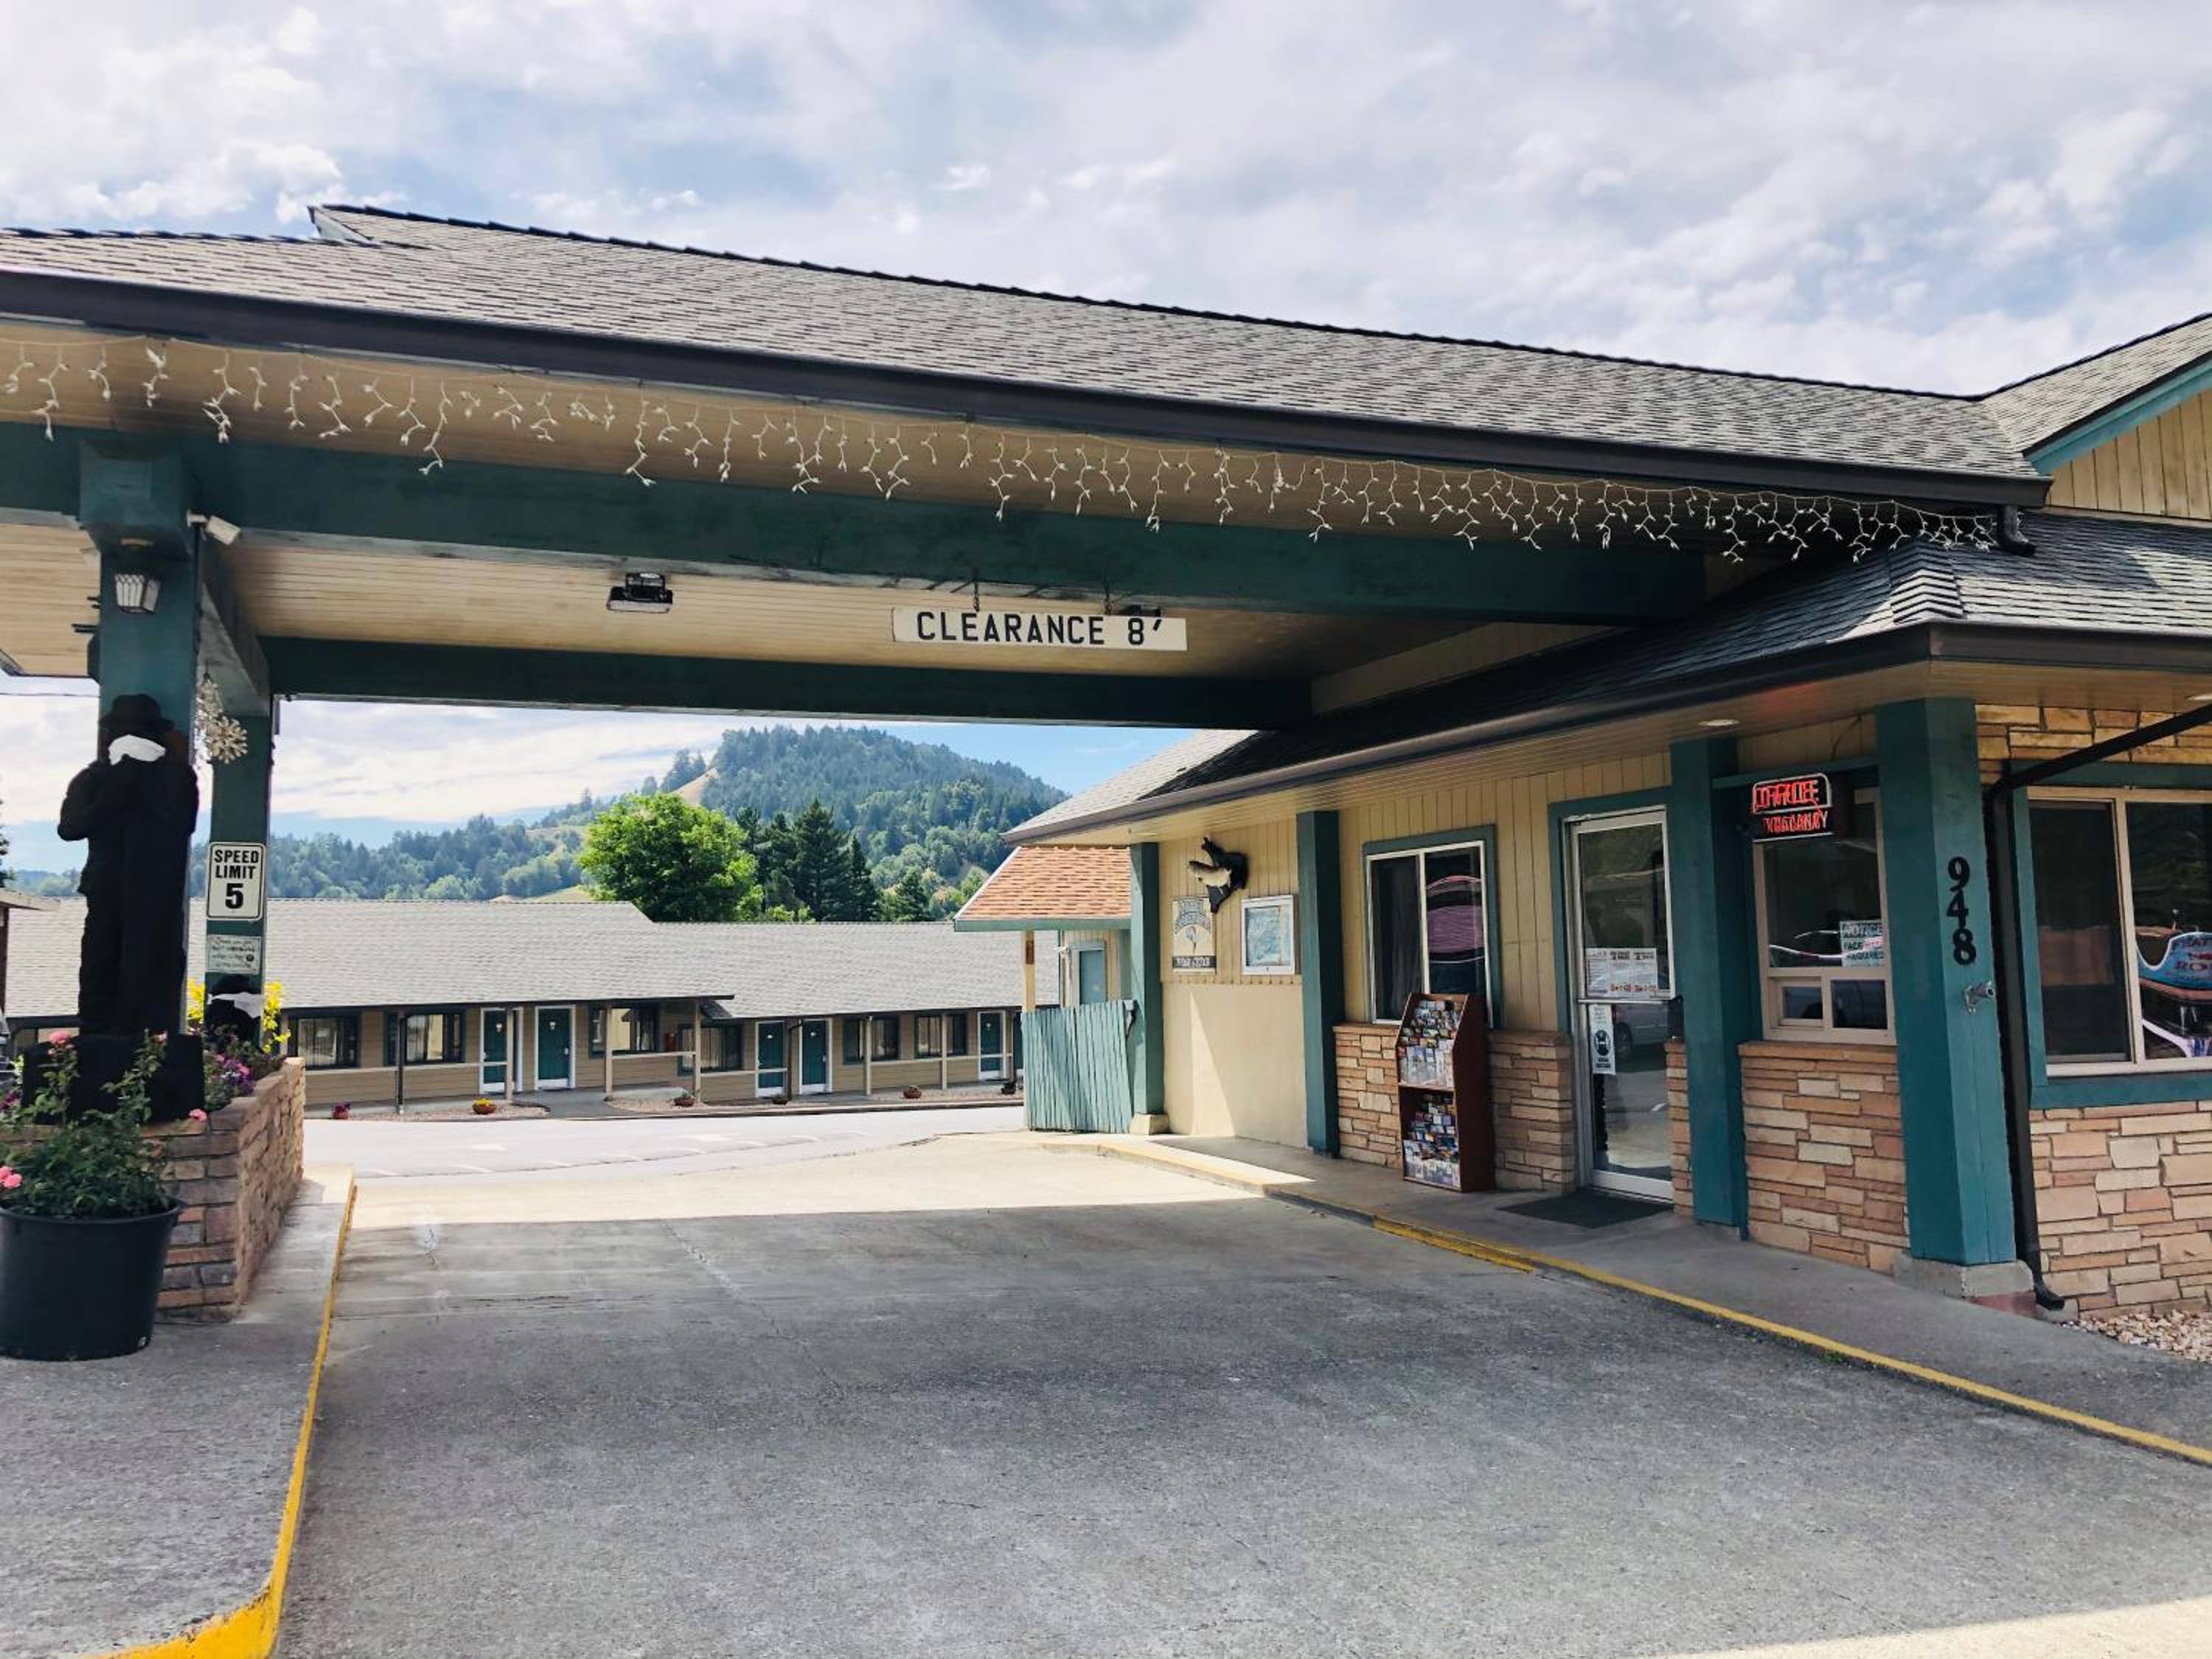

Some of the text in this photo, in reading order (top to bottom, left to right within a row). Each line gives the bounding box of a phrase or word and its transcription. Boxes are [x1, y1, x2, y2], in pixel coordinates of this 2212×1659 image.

[917, 612, 1105, 645] CLEARANCE
[214, 849, 259, 863] SPEED
[215, 865, 257, 880] LIMIT
[225, 883, 244, 909] 5
[1947, 856, 1977, 965] 948
